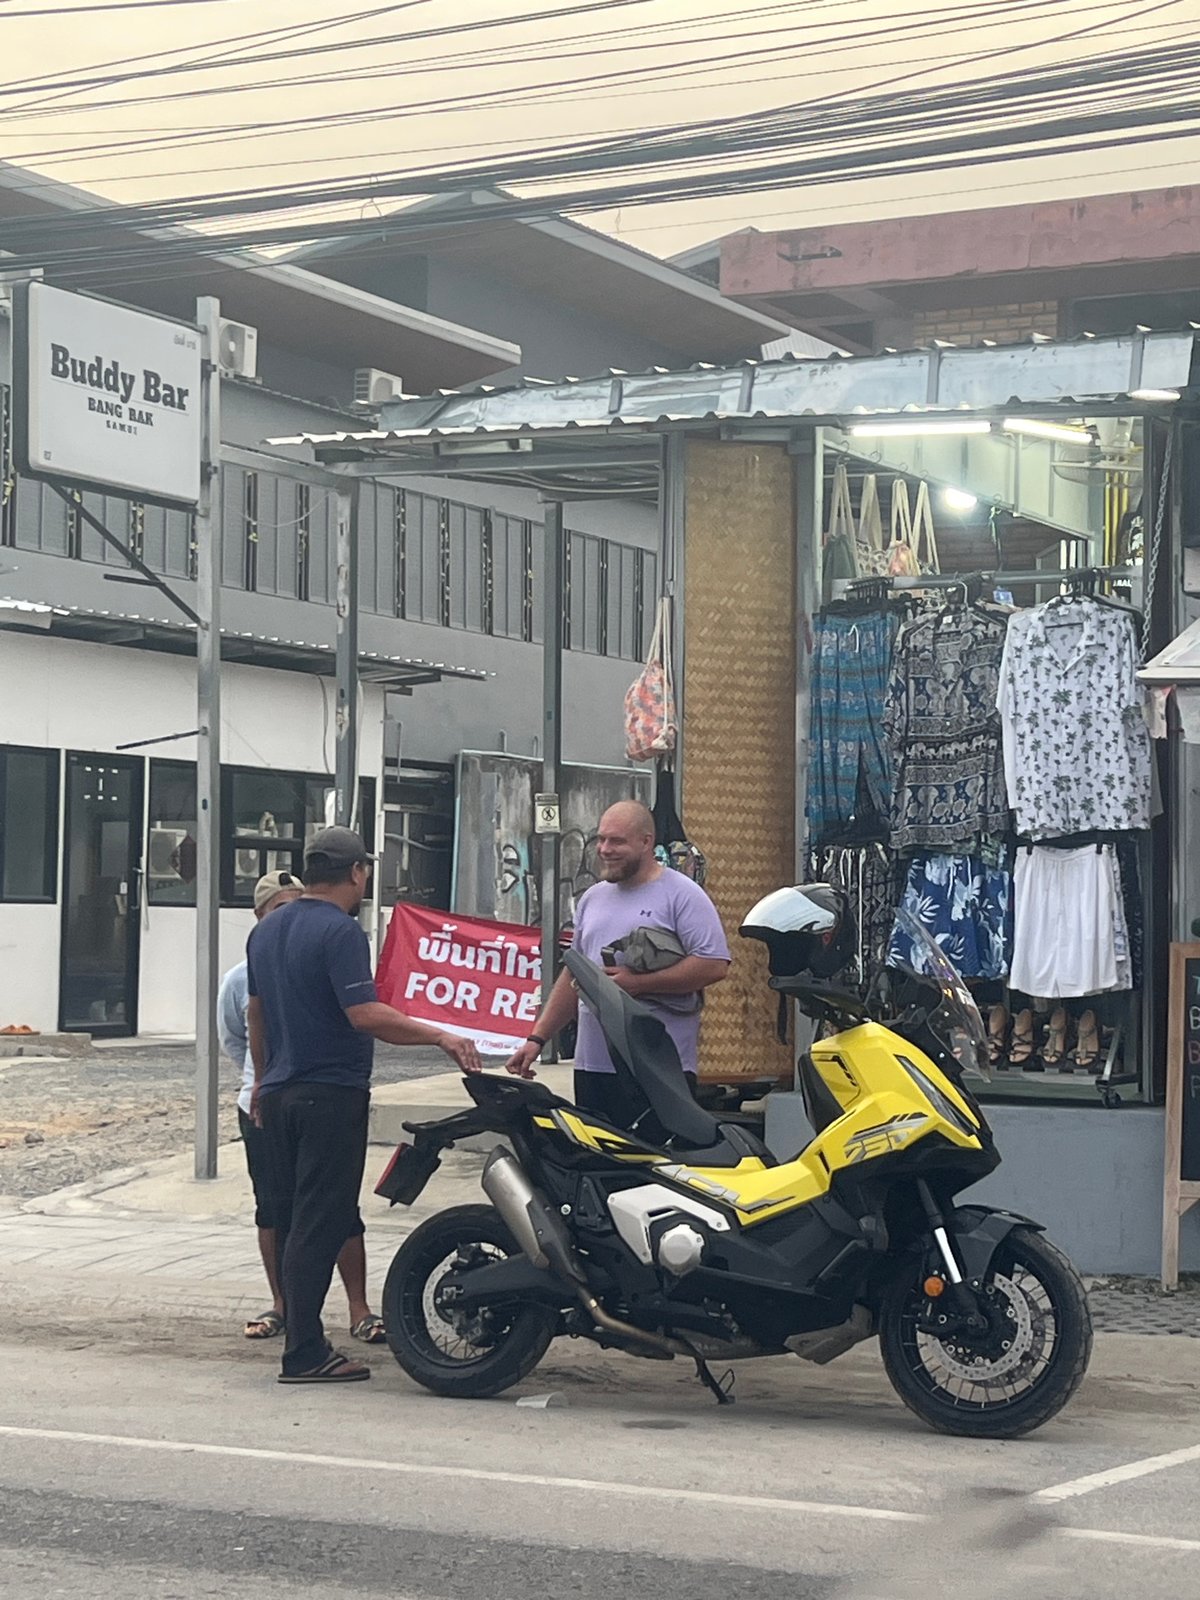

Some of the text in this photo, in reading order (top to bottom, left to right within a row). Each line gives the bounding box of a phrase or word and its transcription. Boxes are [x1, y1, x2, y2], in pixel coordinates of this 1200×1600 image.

[50, 343, 189, 411] Buddy Bar
[87, 397, 123, 418] BANG
[404, 971, 481, 1012] FOR
